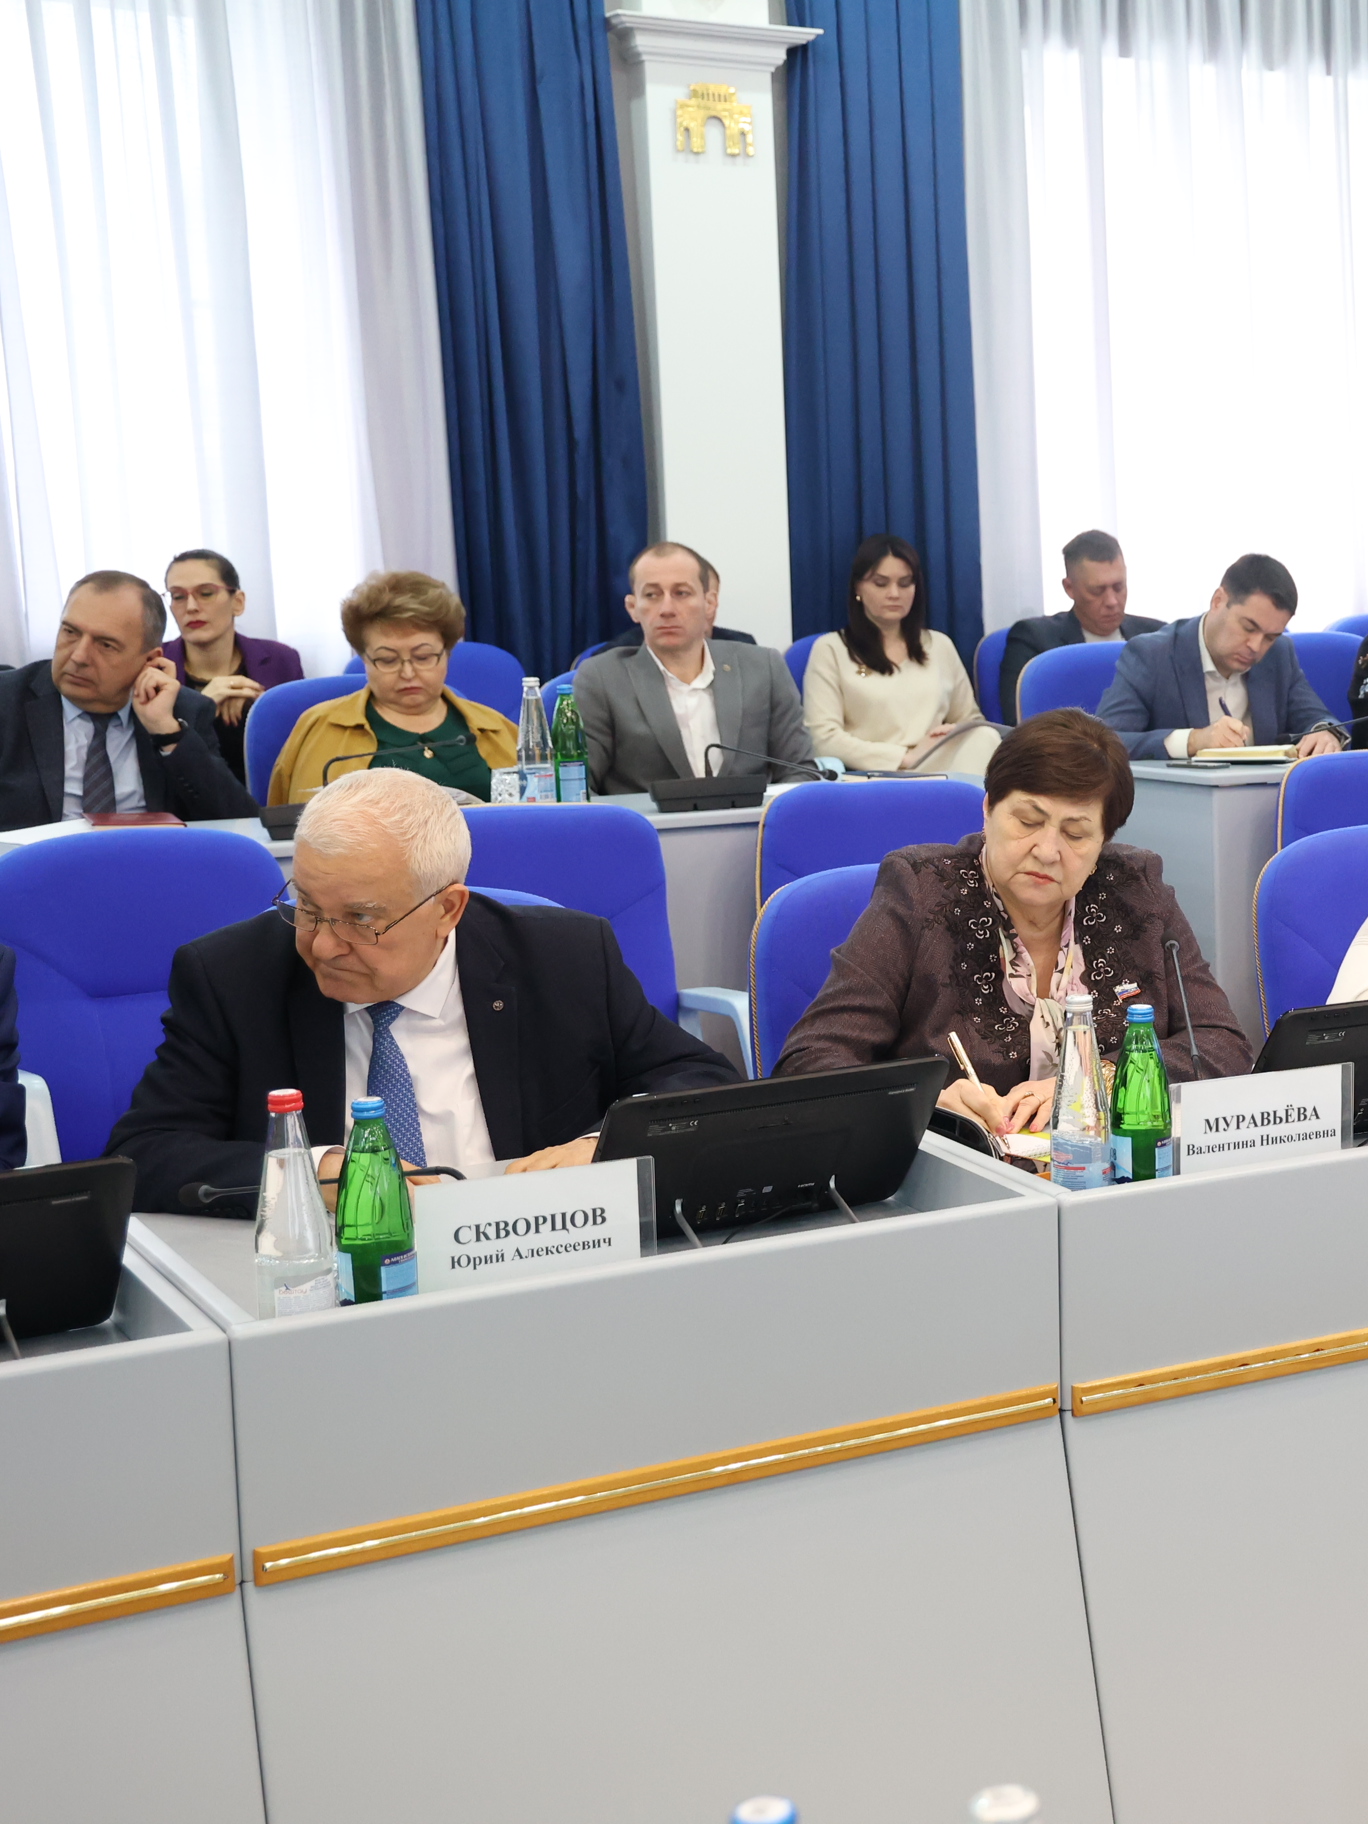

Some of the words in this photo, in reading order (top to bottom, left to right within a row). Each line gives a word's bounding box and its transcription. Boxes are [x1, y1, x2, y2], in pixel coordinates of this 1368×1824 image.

[1203, 1104, 1321, 1135] МУРАВЬЁВА
[1186, 1137, 1256, 1157] Валентина
[1259, 1128, 1337, 1147] Николаевна
[453, 1206, 607, 1245] СКВОРЦОВ
[450, 1249, 506, 1271] Юрий
[511, 1236, 613, 1262] Алексеевич
